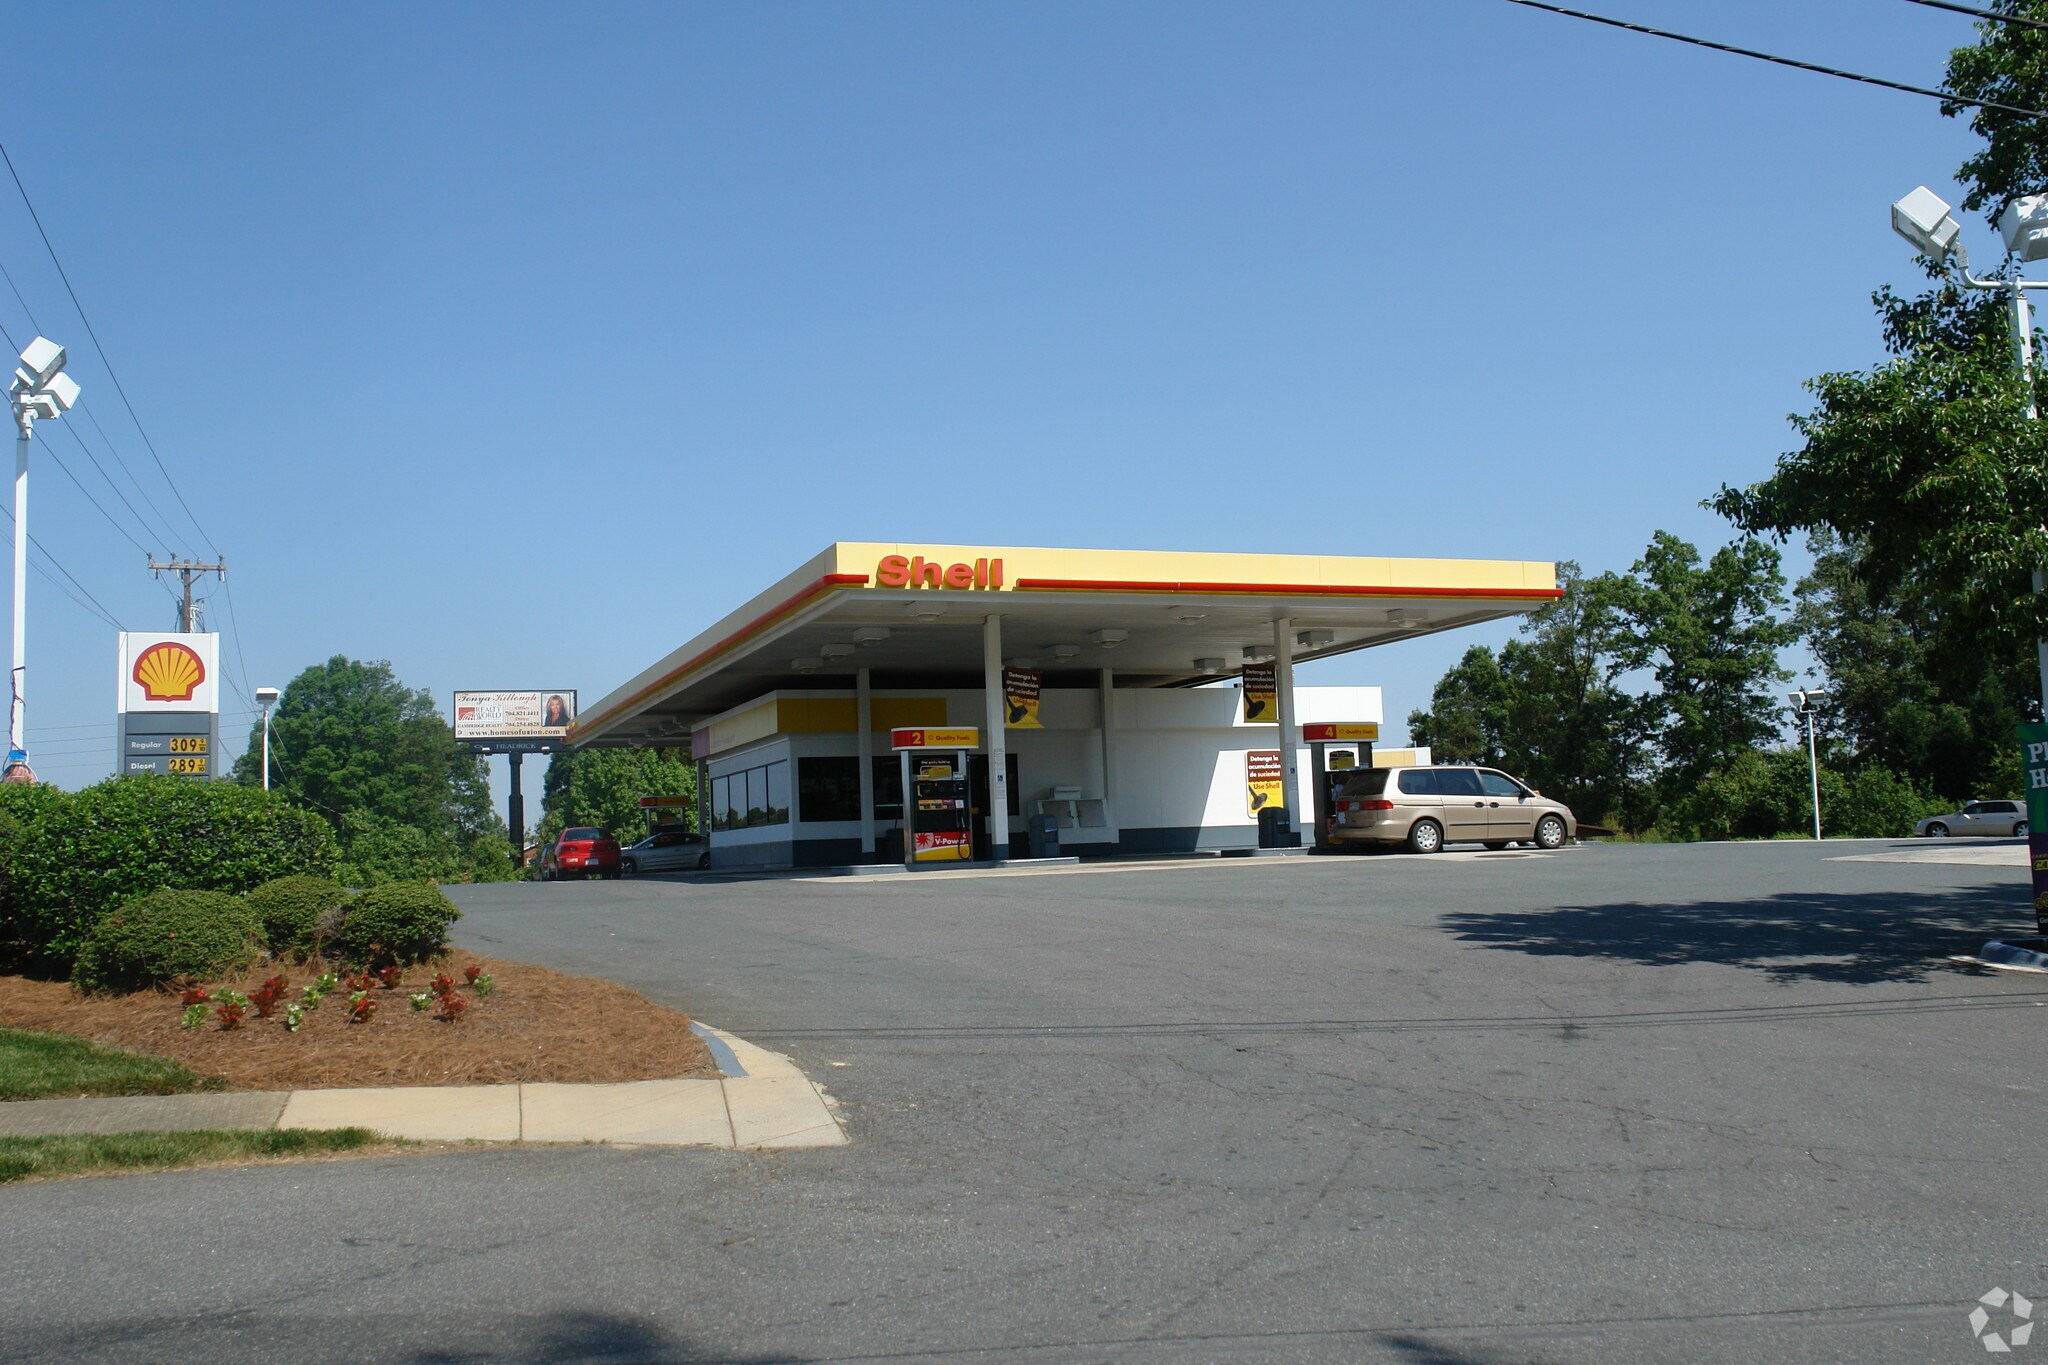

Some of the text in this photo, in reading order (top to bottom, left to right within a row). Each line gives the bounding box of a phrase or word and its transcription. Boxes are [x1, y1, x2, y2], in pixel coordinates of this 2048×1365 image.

[876, 555, 1003, 589] Shell
[1245, 668, 1267, 676] Detenga
[911, 732, 921, 744] 2
[1325, 726, 1334, 737] 4
[131, 741, 162, 749] Regular
[171, 738, 197, 751] 309
[130, 762, 156, 770] Diesel
[169, 759, 196, 772] 289
[2029, 768, 2048, 789] H
